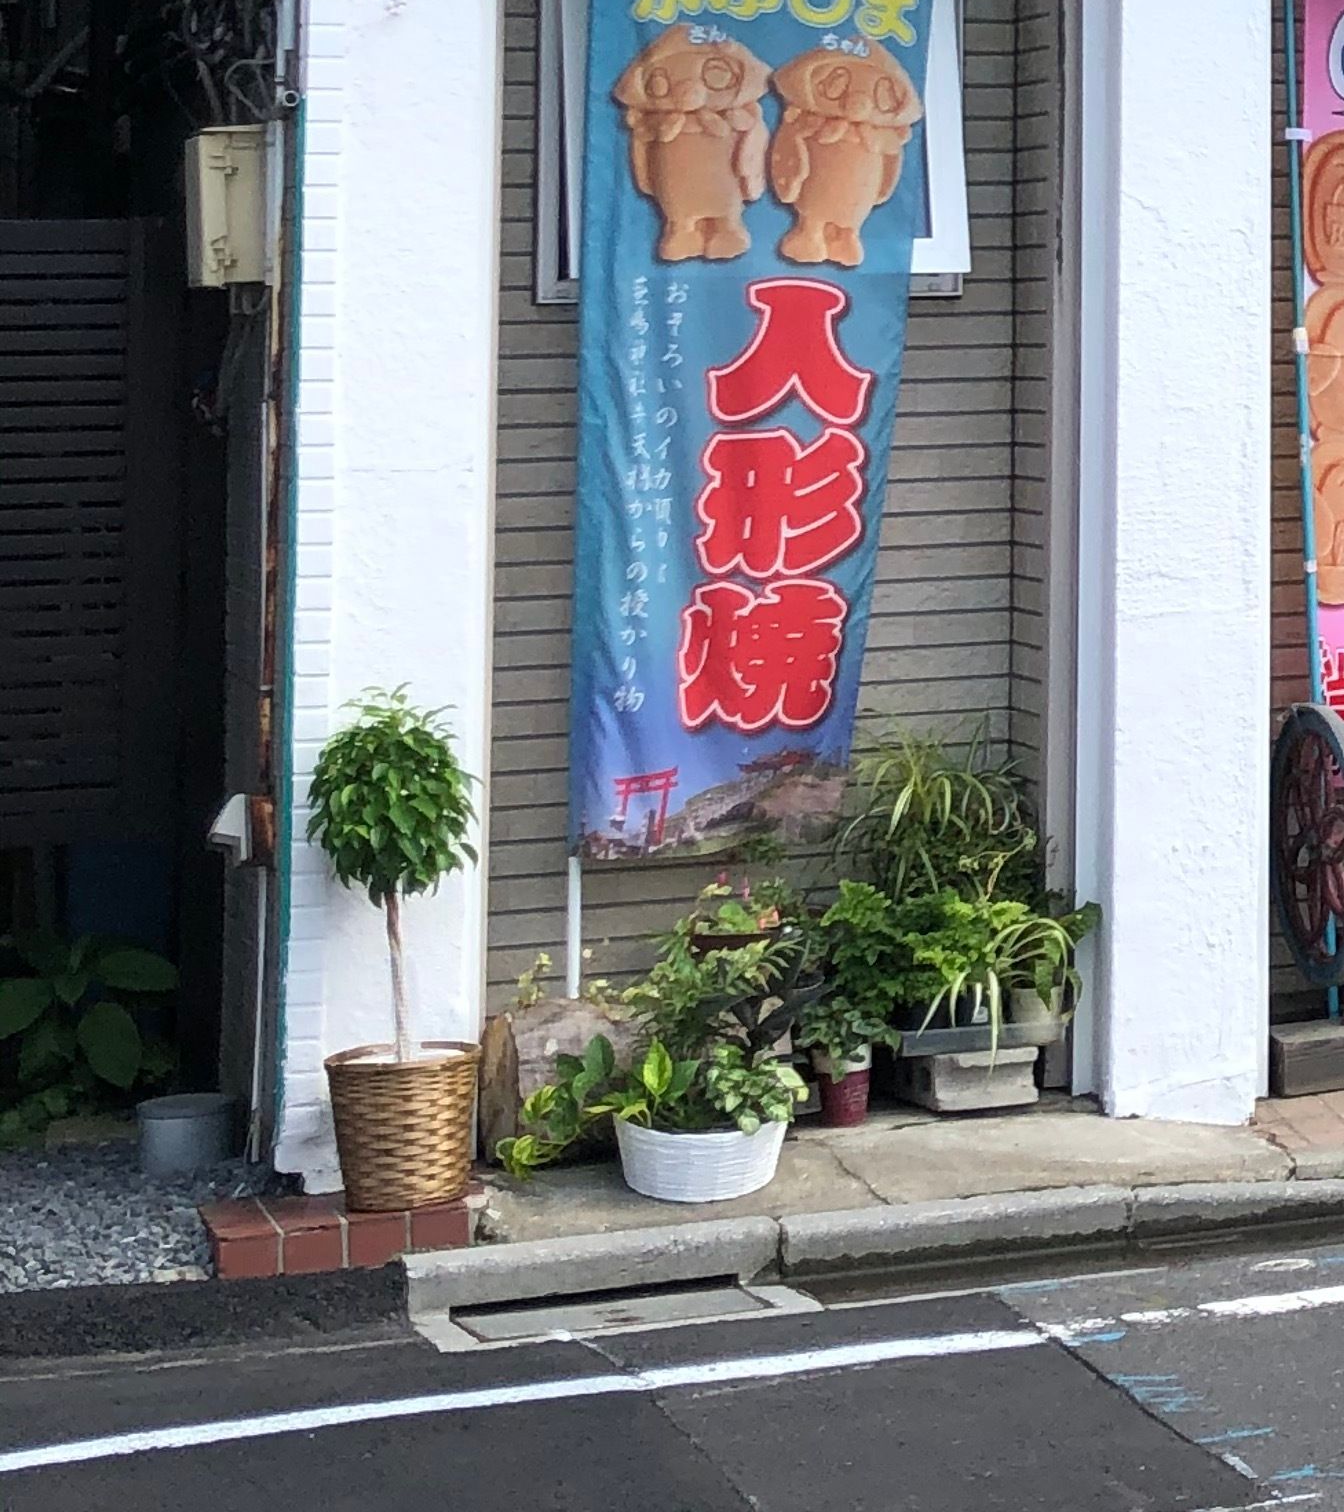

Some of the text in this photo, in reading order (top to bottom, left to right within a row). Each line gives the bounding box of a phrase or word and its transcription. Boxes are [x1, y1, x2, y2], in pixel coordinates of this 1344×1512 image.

[688, 25, 726, 44] さん
[822, 33, 871, 58] ちゃん
[679, 277, 872, 730] 人形焼
